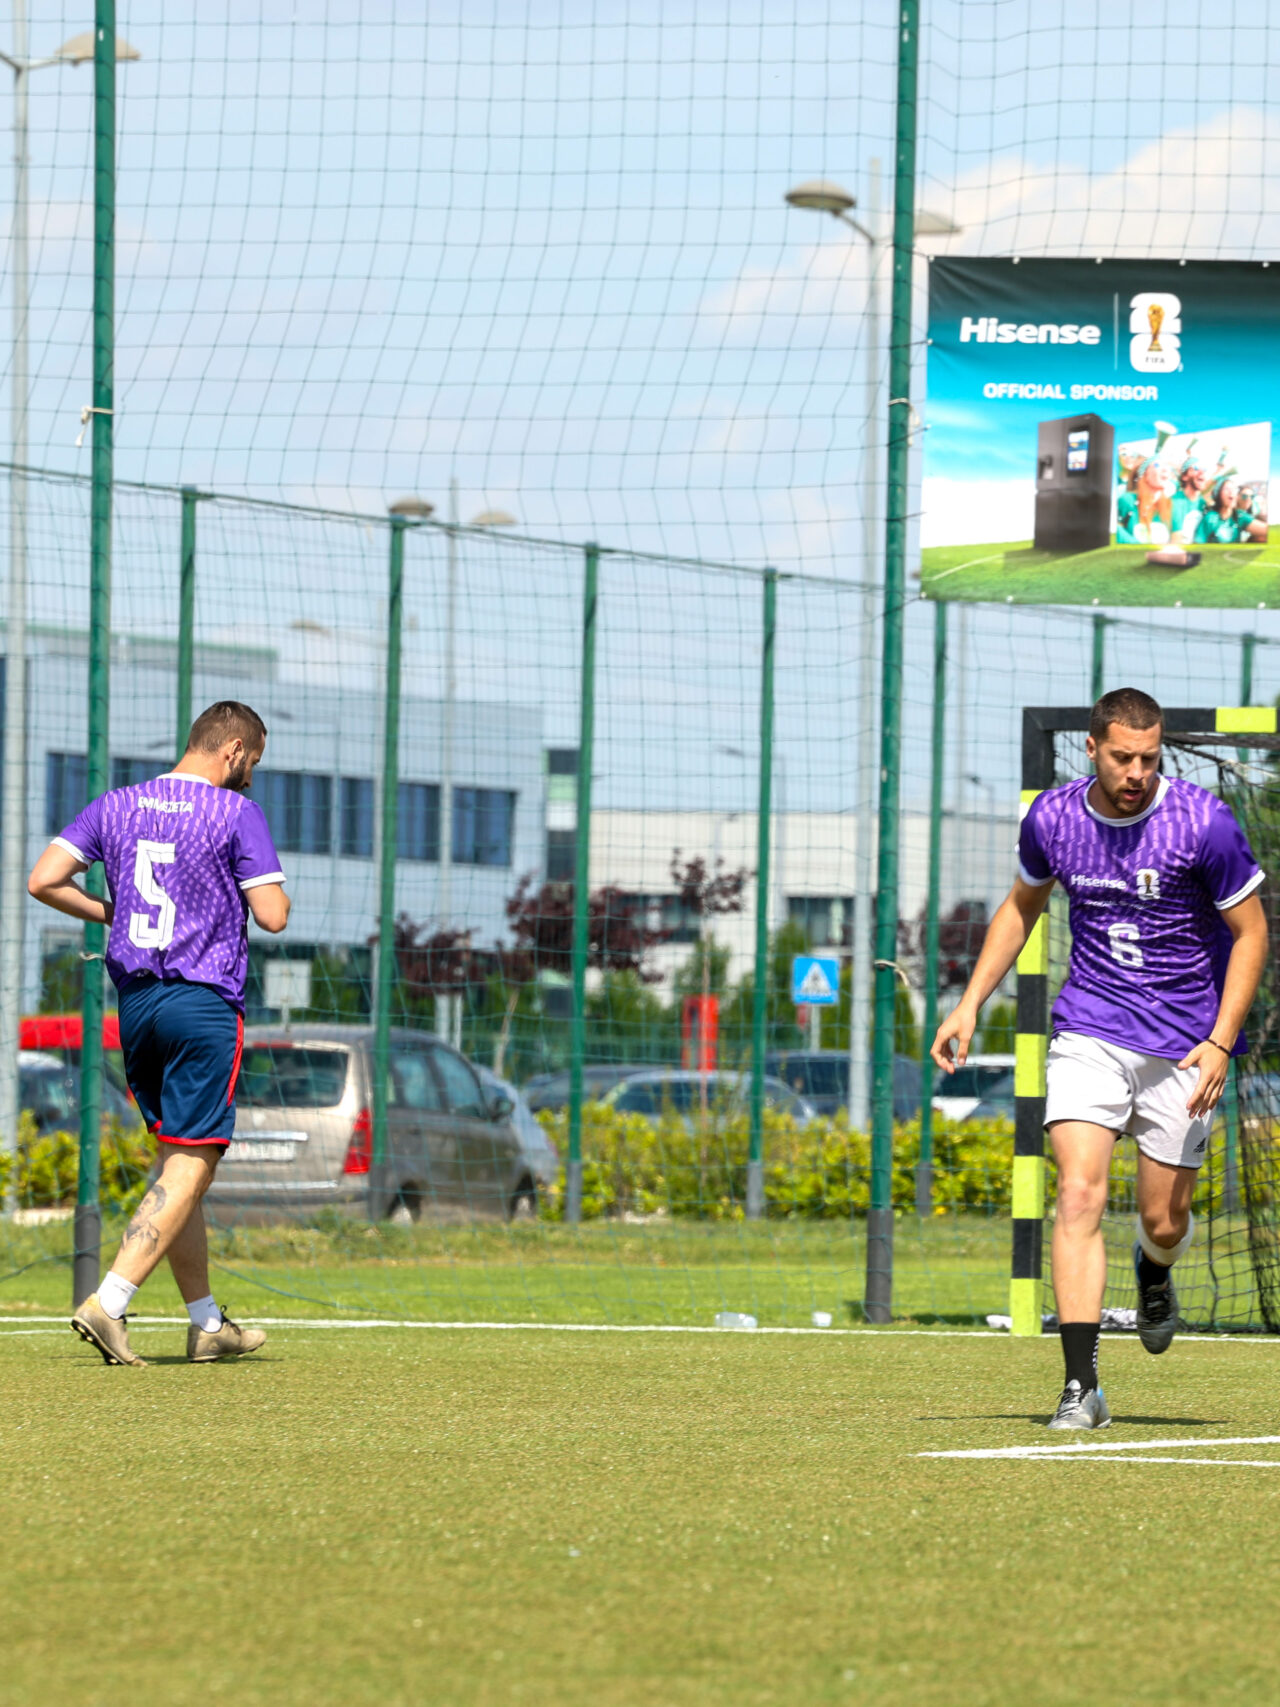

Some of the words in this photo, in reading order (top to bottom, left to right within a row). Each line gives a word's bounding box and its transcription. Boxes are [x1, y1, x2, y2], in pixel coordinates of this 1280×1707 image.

[959, 317, 1102, 345] Hisense
[983, 383, 1066, 400] OFFICIAL
[1070, 384, 1159, 401] SPONSOR
[137, 796, 194, 814] EMMEZETA
[1071, 874, 1128, 890] Hisense
[128, 839, 177, 951] 5
[1107, 923, 1145, 967] 6
